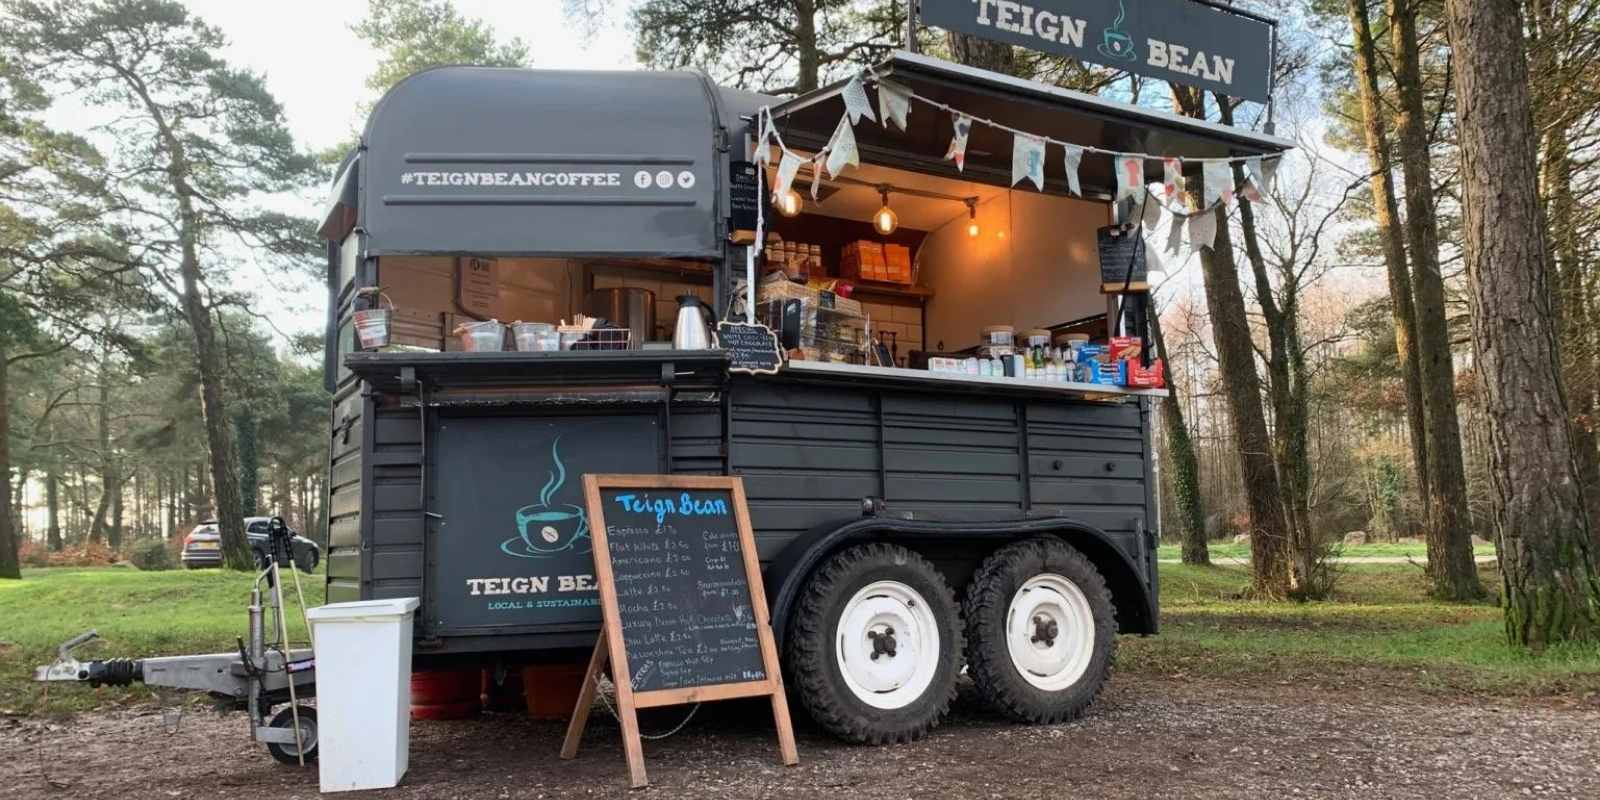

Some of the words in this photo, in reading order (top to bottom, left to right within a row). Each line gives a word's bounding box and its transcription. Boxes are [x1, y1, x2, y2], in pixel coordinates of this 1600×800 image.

[972, 0, 1087, 48] TEIGN
[1147, 38, 1235, 85] BEAN
[400, 171, 621, 187] #TEIGNBEANCOFFEE
[615, 494, 676, 523] Teign
[679, 492, 728, 515] Bean
[466, 576, 550, 595] TEIGN
[558, 575, 600, 592] BE
[487, 601, 523, 610] LOCAL
